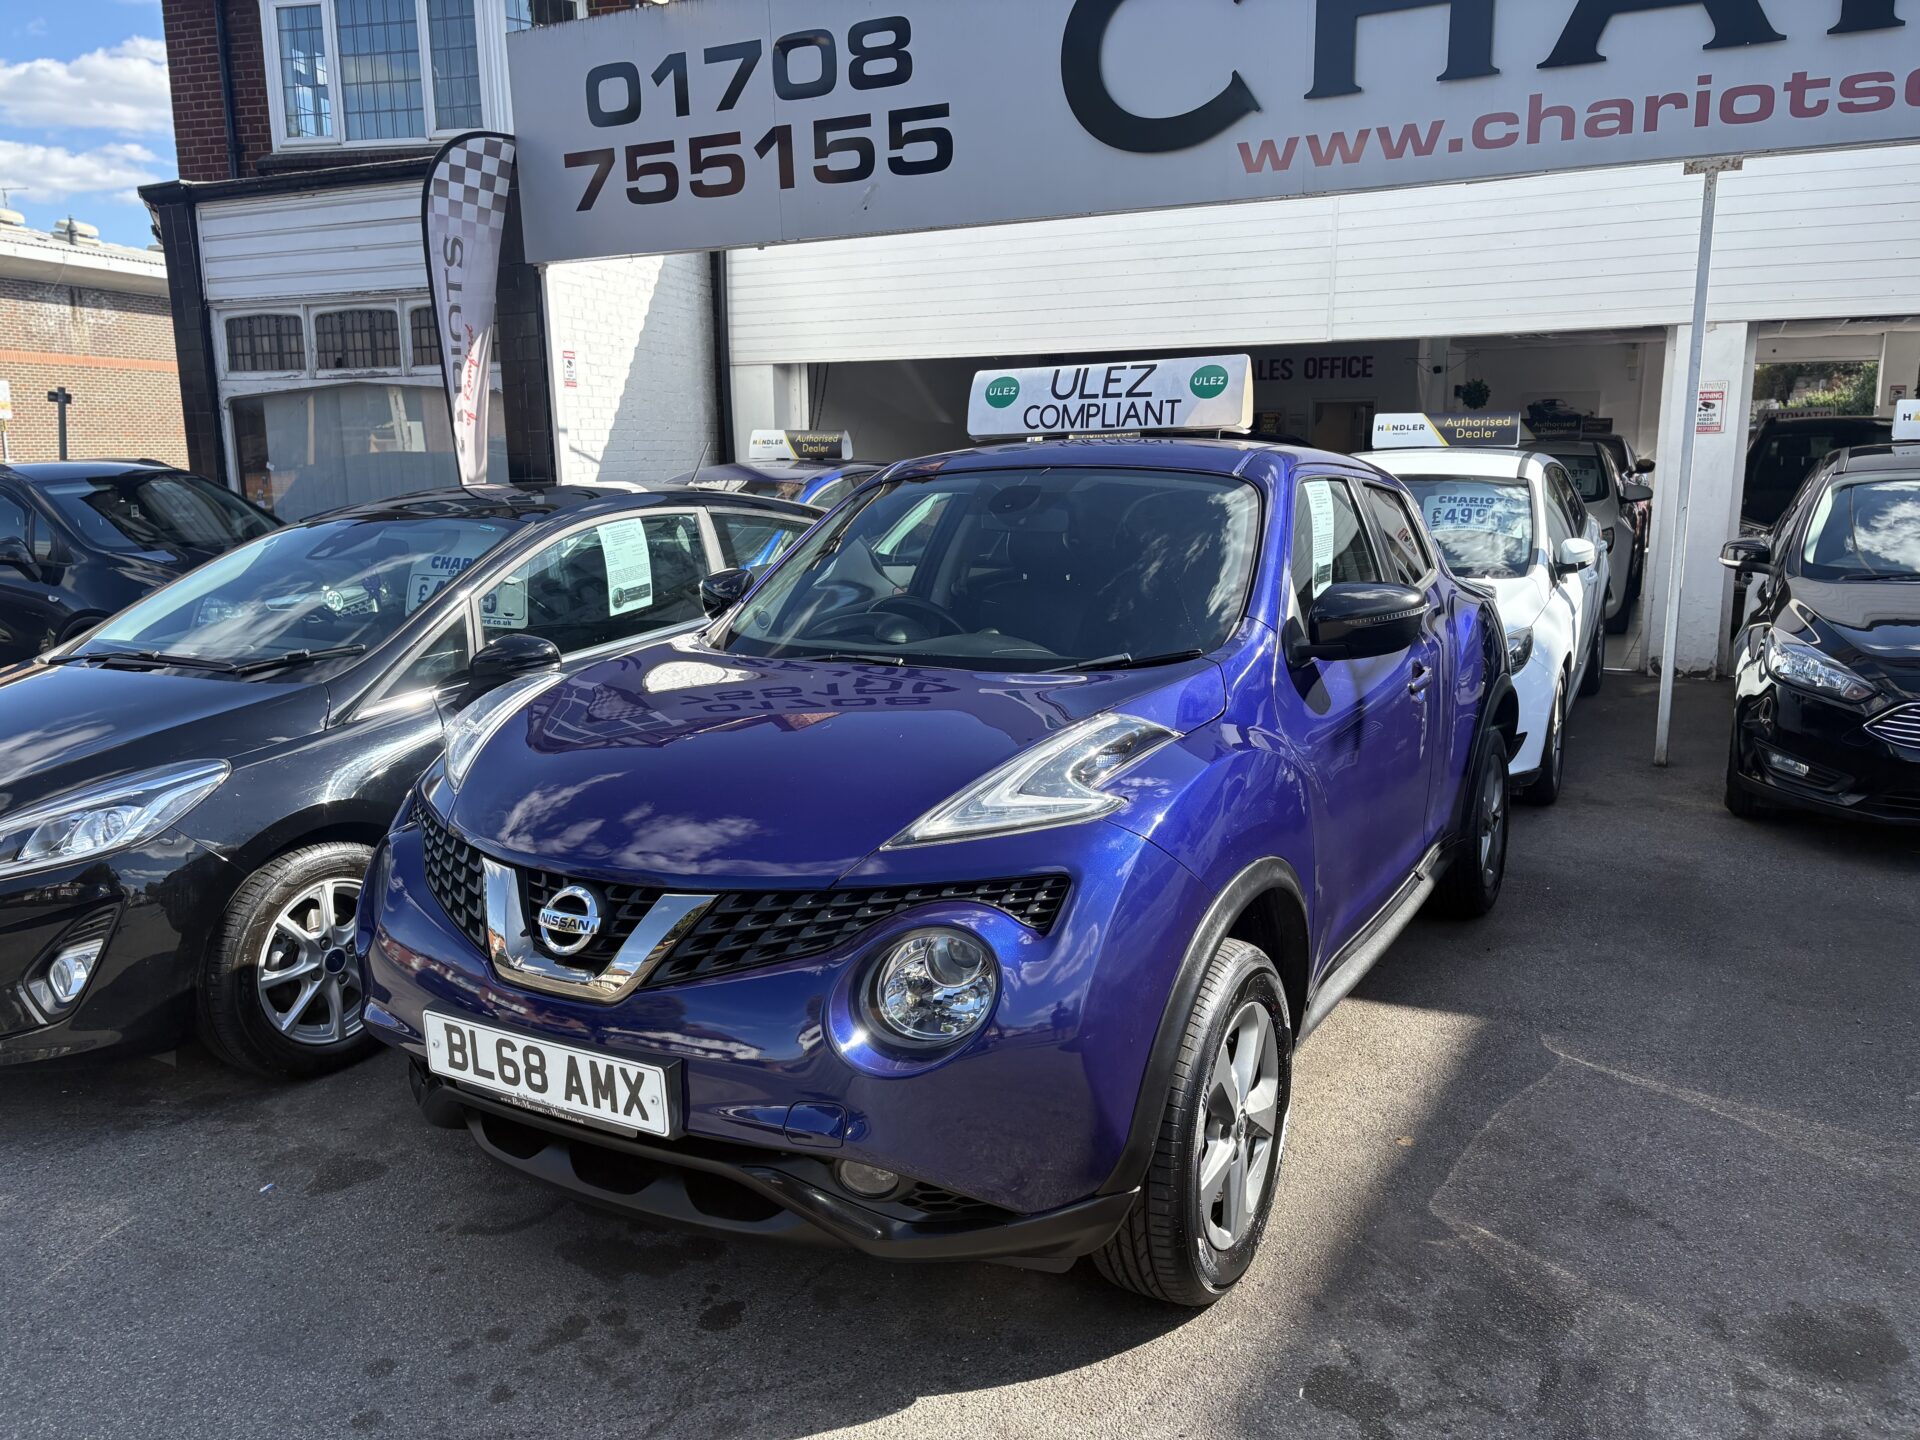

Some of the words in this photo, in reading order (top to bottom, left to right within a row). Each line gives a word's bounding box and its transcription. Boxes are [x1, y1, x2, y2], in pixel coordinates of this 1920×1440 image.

[585, 15, 913, 128] 01708
[563, 102, 954, 212] 755155
[1303, 356, 1374, 380] OFFICE
[1051, 364, 1158, 401] ULEZ
[1194, 375, 1225, 387] ULEZ
[989, 386, 1017, 397] ULEZ
[1023, 399, 1182, 430] COMPLIANT
[1444, 416, 1511, 427] Authorised
[795, 434, 840, 444] Authorised
[1456, 427, 1497, 439] Dealer
[802, 443, 829, 453] Dealer
[540, 912, 590, 931] NISSAN
[443, 1022, 549, 1094] BL68
[564, 1055, 649, 1122] AMX
